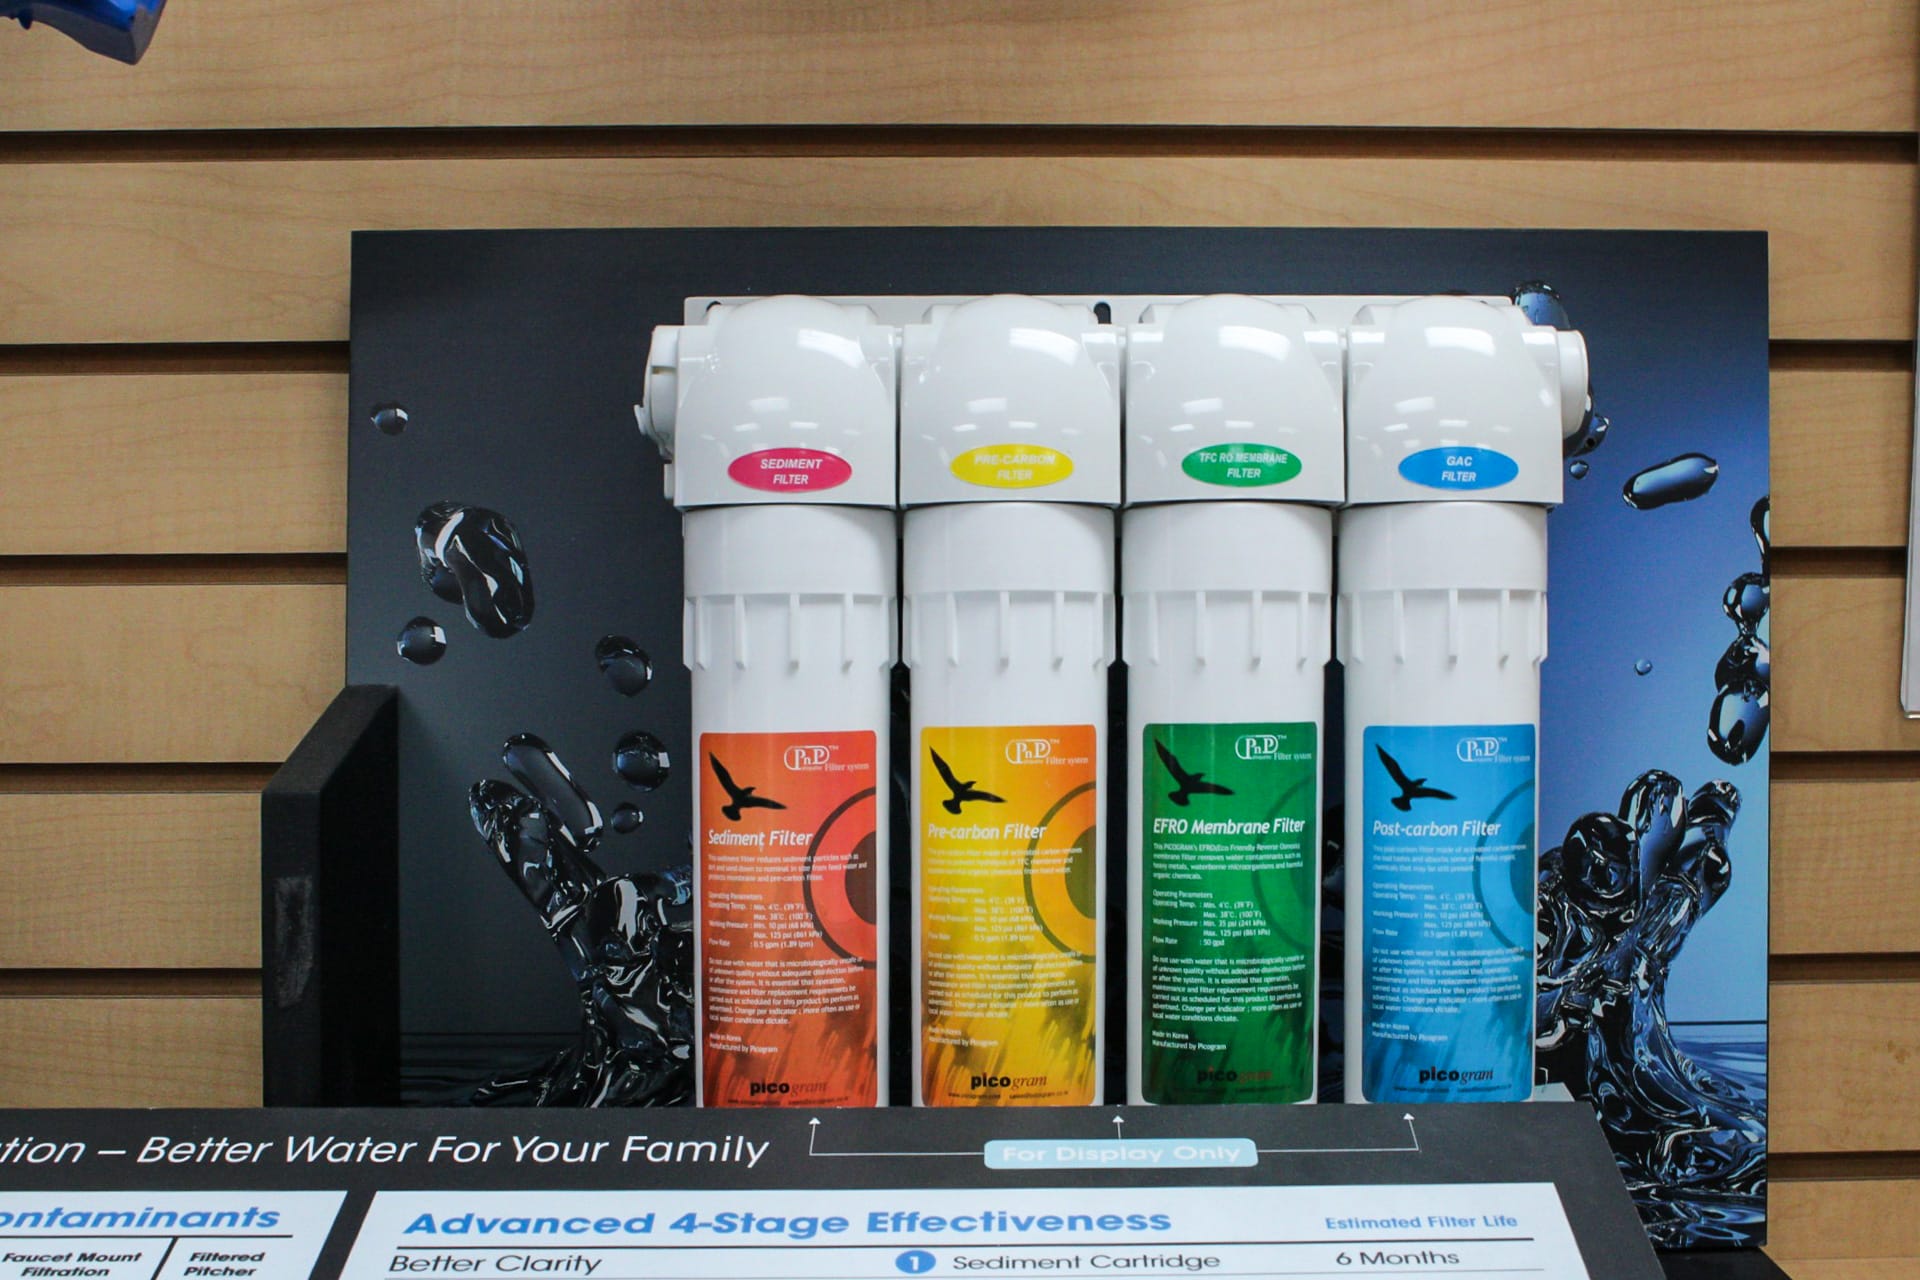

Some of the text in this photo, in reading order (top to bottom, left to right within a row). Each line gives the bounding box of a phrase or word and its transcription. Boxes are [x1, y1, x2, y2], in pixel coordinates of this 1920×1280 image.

[974, 454, 1056, 465] PRE-CARBON
[1200, 452, 1288, 464] TFC RO MEMBRANE
[1446, 456, 1472, 467] GAC
[760, 459, 822, 470] SEDIMENT
[997, 470, 1033, 480] FILTER
[1227, 468, 1262, 478] FILTER
[1442, 471, 1477, 482] FILTER
[772, 474, 808, 485] FILTER
[1153, 817, 1306, 834] EFRO Membrane Filter
[1372, 820, 1502, 836] Post-carbon Filter
[928, 823, 1047, 840] Pre-carbon Filter
[708, 829, 814, 847] Sediment Filter
[1198, 1042, 1226, 1051] Picogram
[0, 1136, 86, 1163] tion
[136, 1136, 273, 1164] Better
[285, 1136, 418, 1164] Water
[428, 1136, 500, 1163] For
[512, 1136, 610, 1163] Your
[622, 1135, 770, 1168] Family
[1002, 1144, 1240, 1165] For Display Only
[402, 1210, 1172, 1239] Advanced 4-Stage Effectiveness
[1325, 1214, 1518, 1230] Estimated Filter Life
[2, 1252, 142, 1262] Faucet Mount
[190, 1252, 265, 1262] Filtered
[1336, 1251, 1460, 1266] 6 Months
[388, 1254, 603, 1276] Better Clarity
[908, 1254, 1221, 1272] 1 Sediment Cartridge
[21, 1266, 110, 1277] Filtration
[184, 1266, 257, 1277] Pitcher
